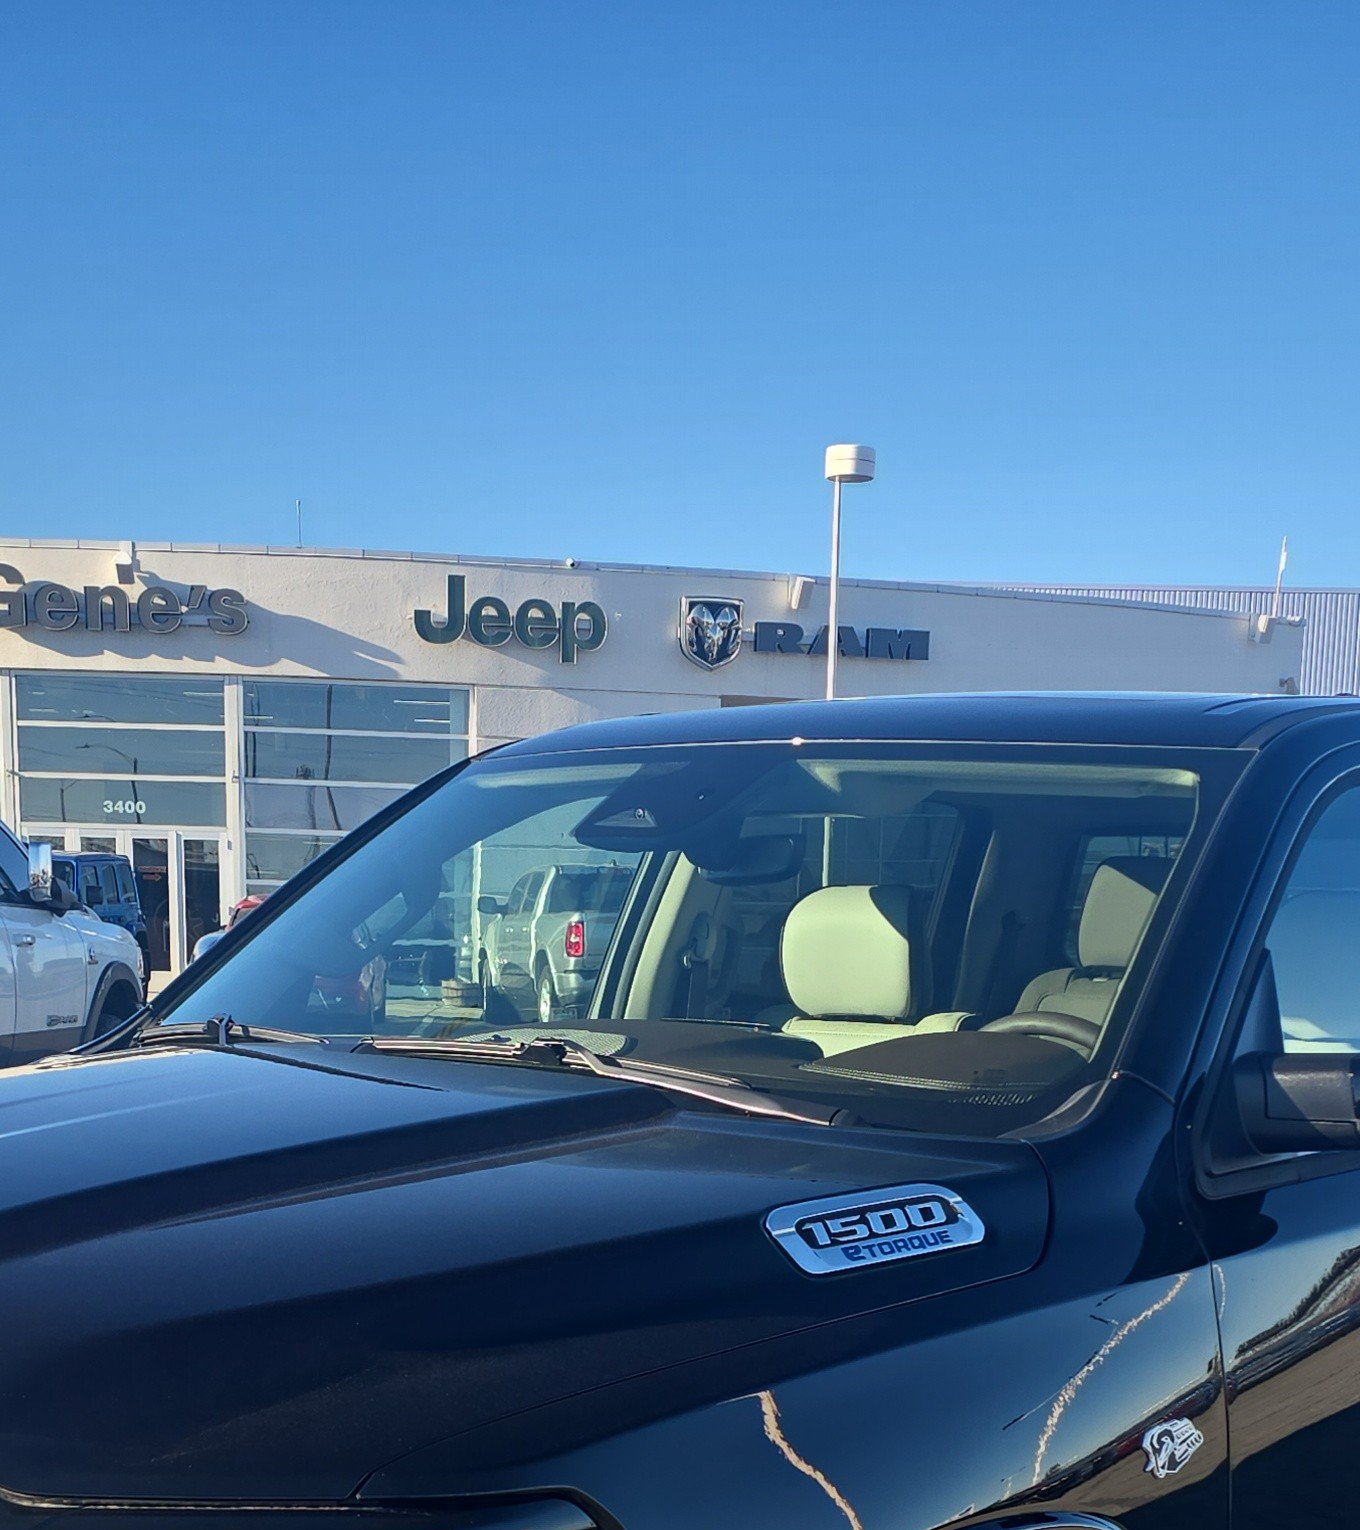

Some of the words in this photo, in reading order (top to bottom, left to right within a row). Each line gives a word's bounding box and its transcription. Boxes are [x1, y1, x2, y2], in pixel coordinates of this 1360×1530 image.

[413, 573, 608, 665] Jeep
[754, 621, 930, 661] RAM
[102, 800, 146, 814] 3400
[802, 1201, 947, 1246] 1500
